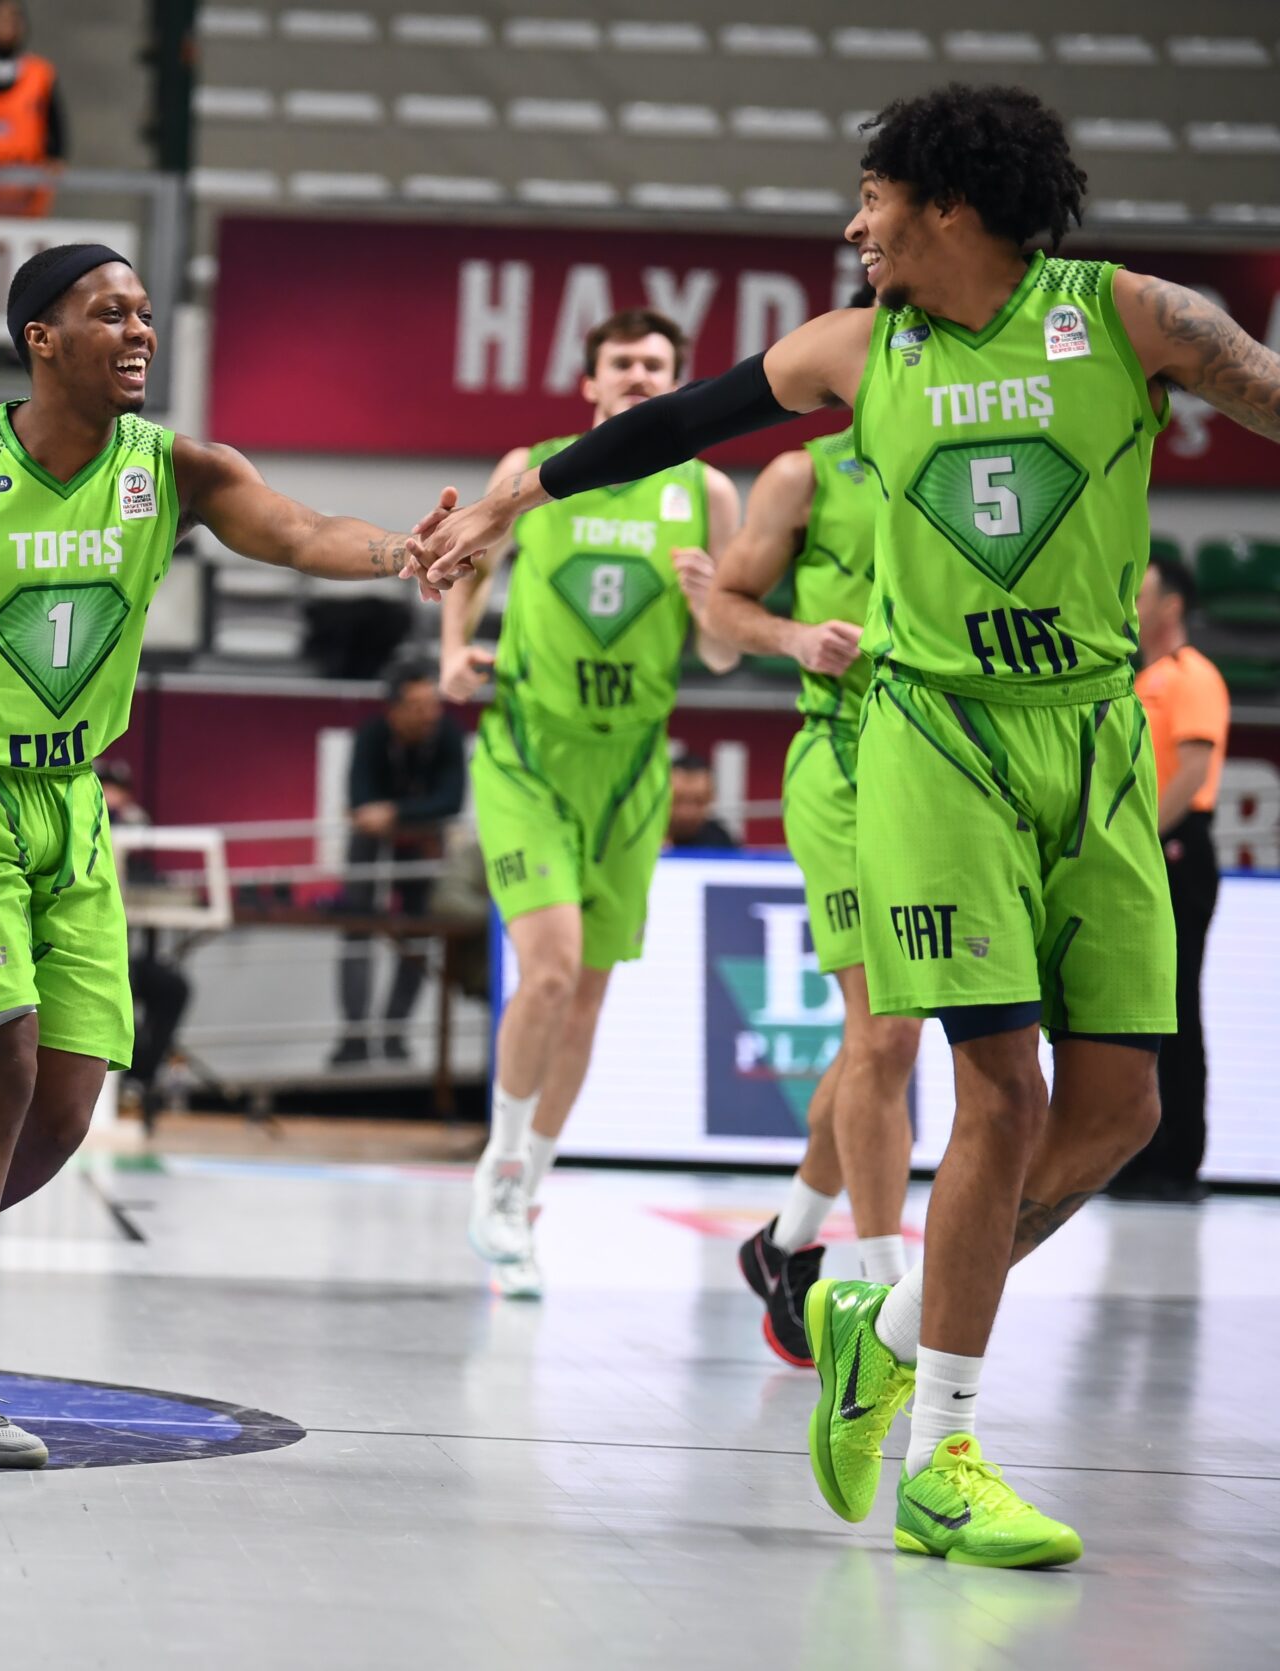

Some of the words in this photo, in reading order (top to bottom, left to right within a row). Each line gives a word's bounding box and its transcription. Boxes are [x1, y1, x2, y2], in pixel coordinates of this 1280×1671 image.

[924, 375, 1054, 428] TOFAŞ
[970, 455, 1022, 537] 5
[8, 527, 122, 574] TOFAŞ
[588, 563, 626, 617] 8
[47, 602, 74, 669] 1
[964, 607, 1079, 675] FIAT
[825, 888, 861, 934] FIA
[890, 904, 958, 960] FIAT
